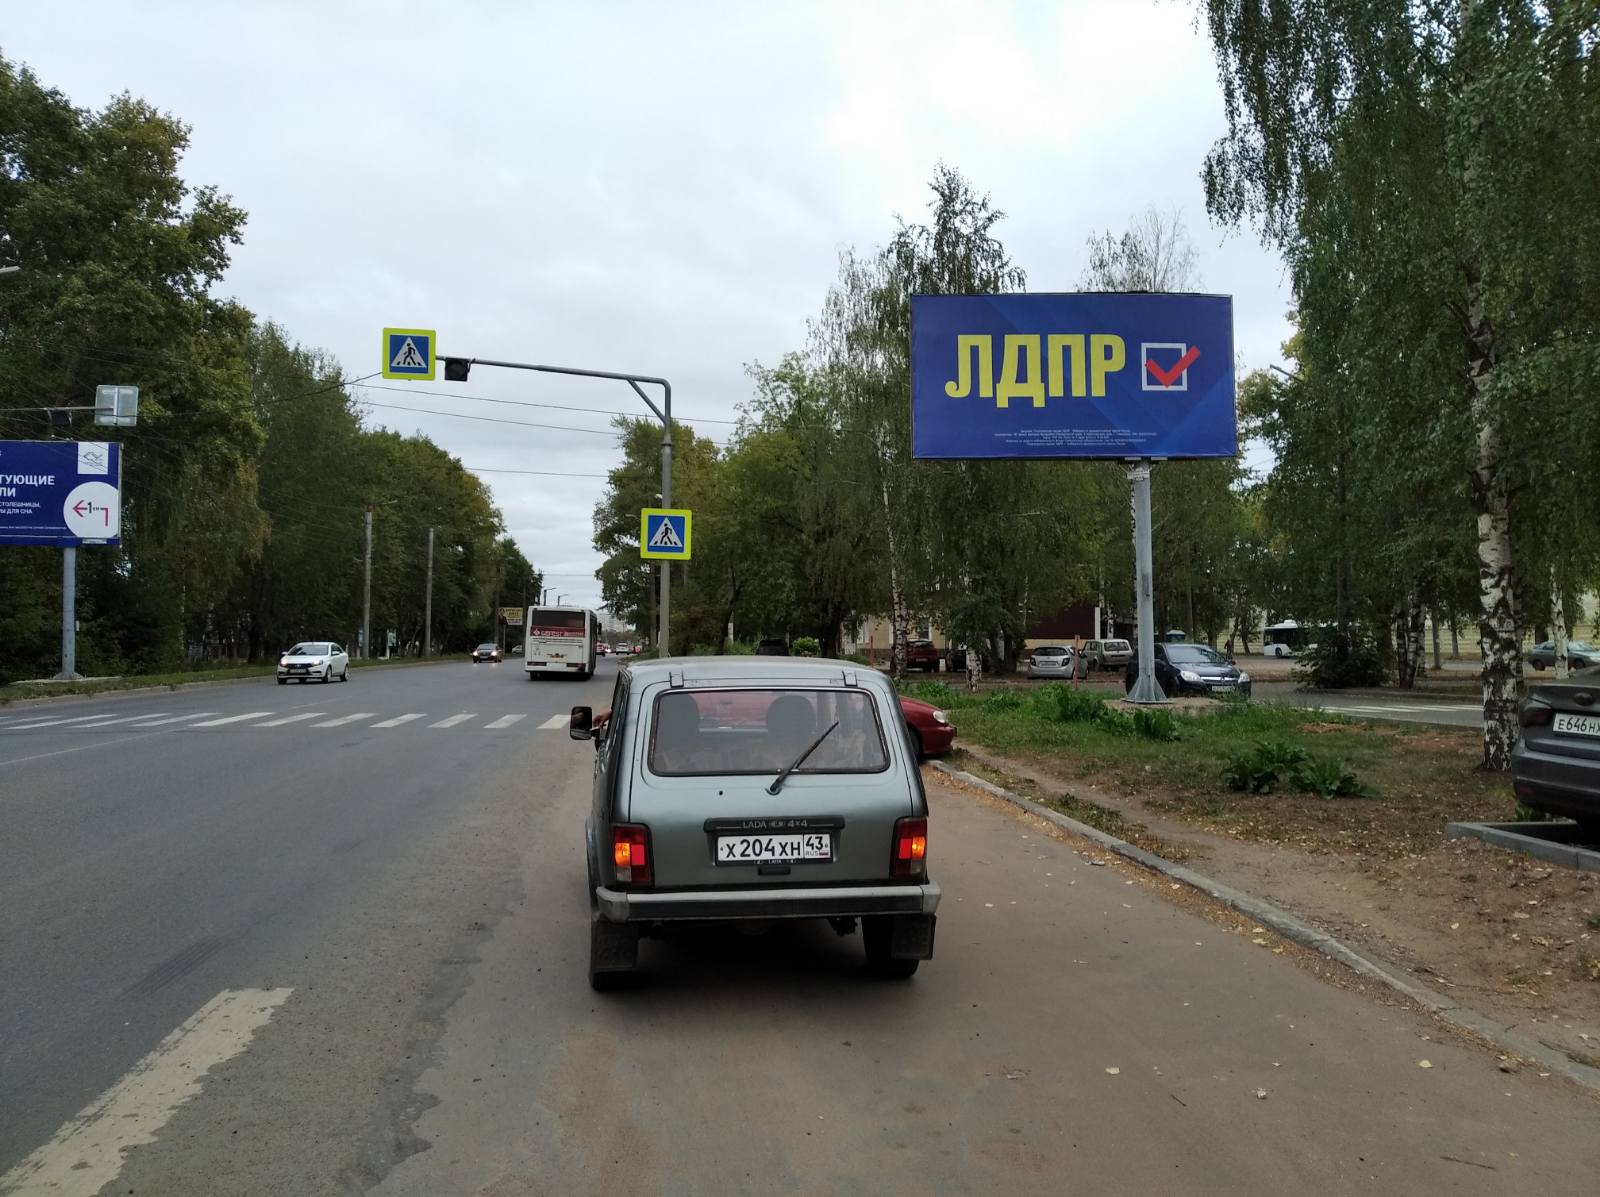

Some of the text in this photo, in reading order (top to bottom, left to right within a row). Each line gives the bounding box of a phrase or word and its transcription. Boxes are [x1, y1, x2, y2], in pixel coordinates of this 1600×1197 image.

[944, 334, 1126, 408] ЛДПР
[87, 501, 92, 514] 1
[743, 820, 767, 828] LADA
[805, 836, 824, 850] 43
